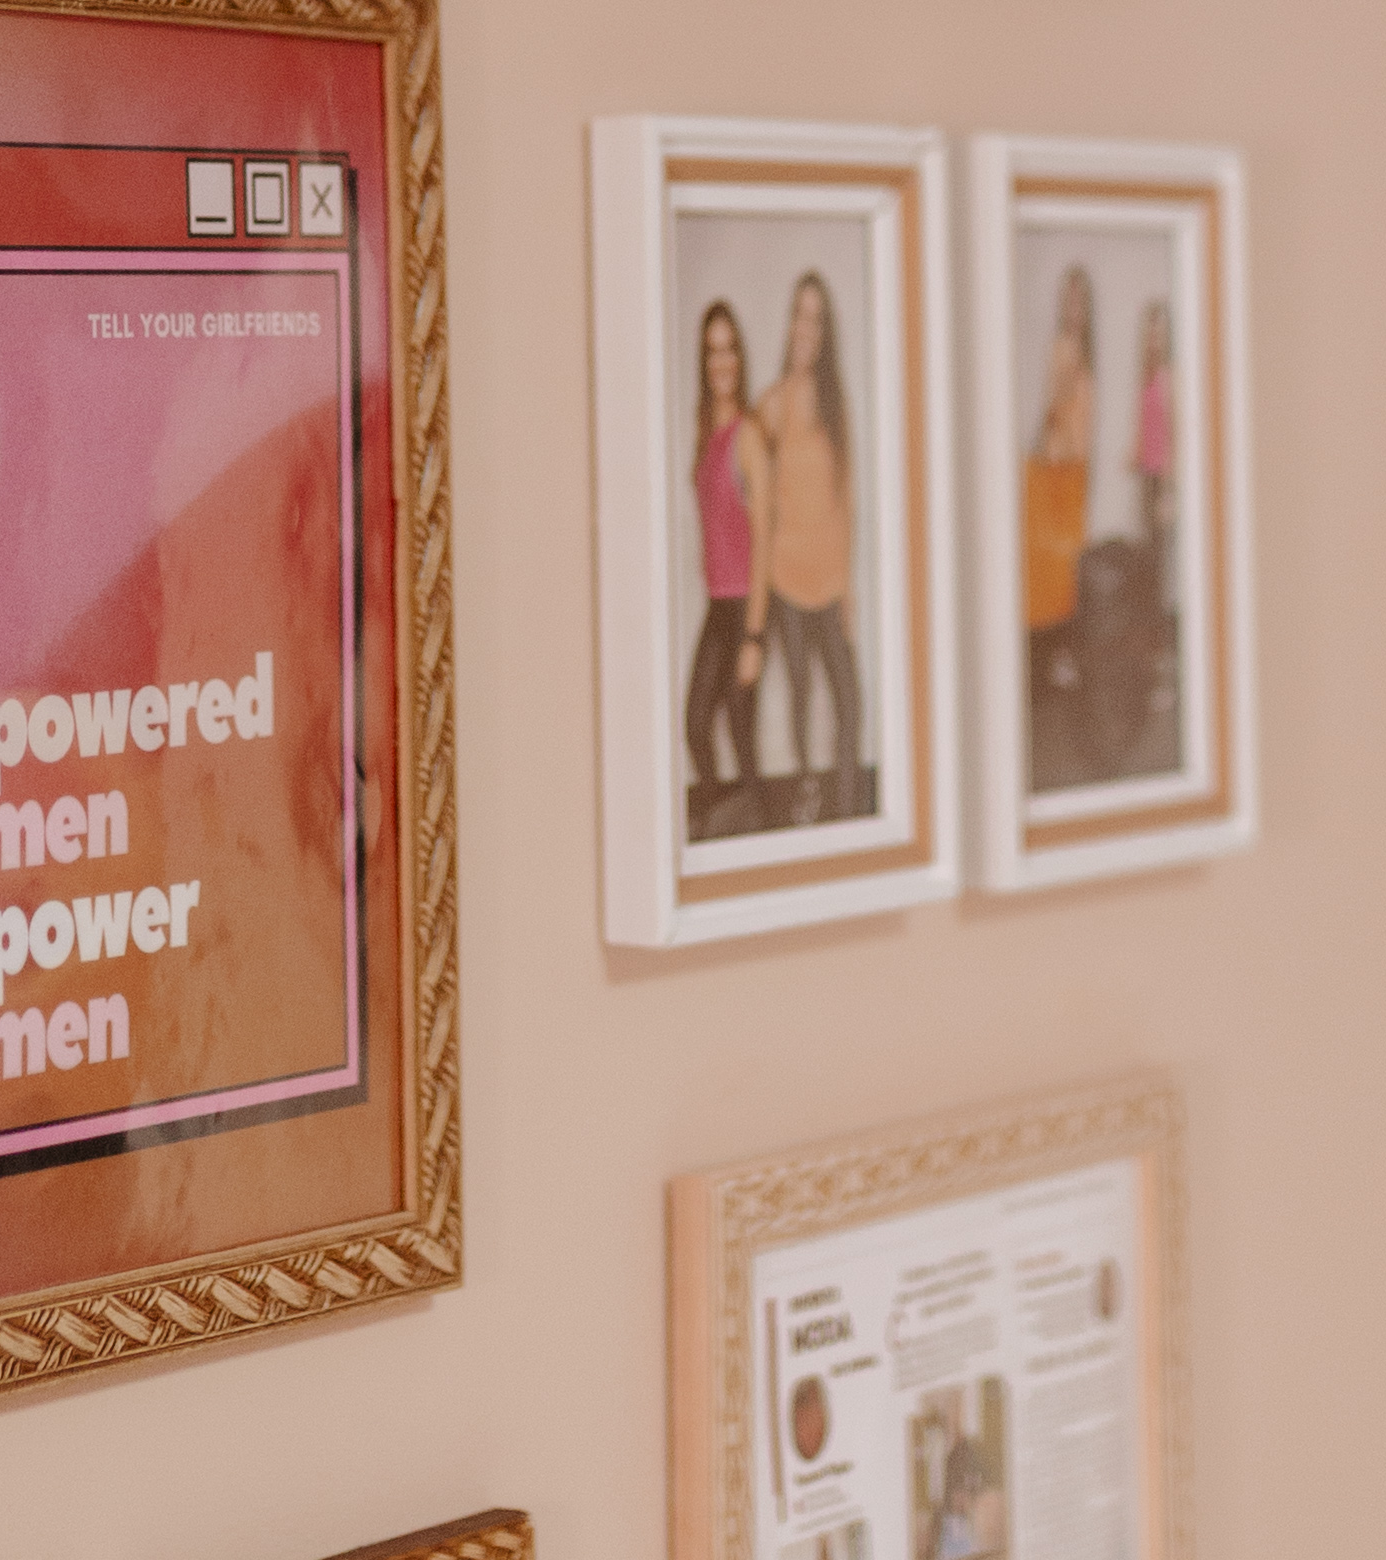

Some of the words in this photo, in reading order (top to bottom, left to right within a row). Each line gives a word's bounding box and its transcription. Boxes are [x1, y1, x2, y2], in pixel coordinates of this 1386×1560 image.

[88, 312, 135, 339] TELL
[140, 311, 197, 338] YOUR
[201, 310, 322, 337] GIRLFRIENDS
